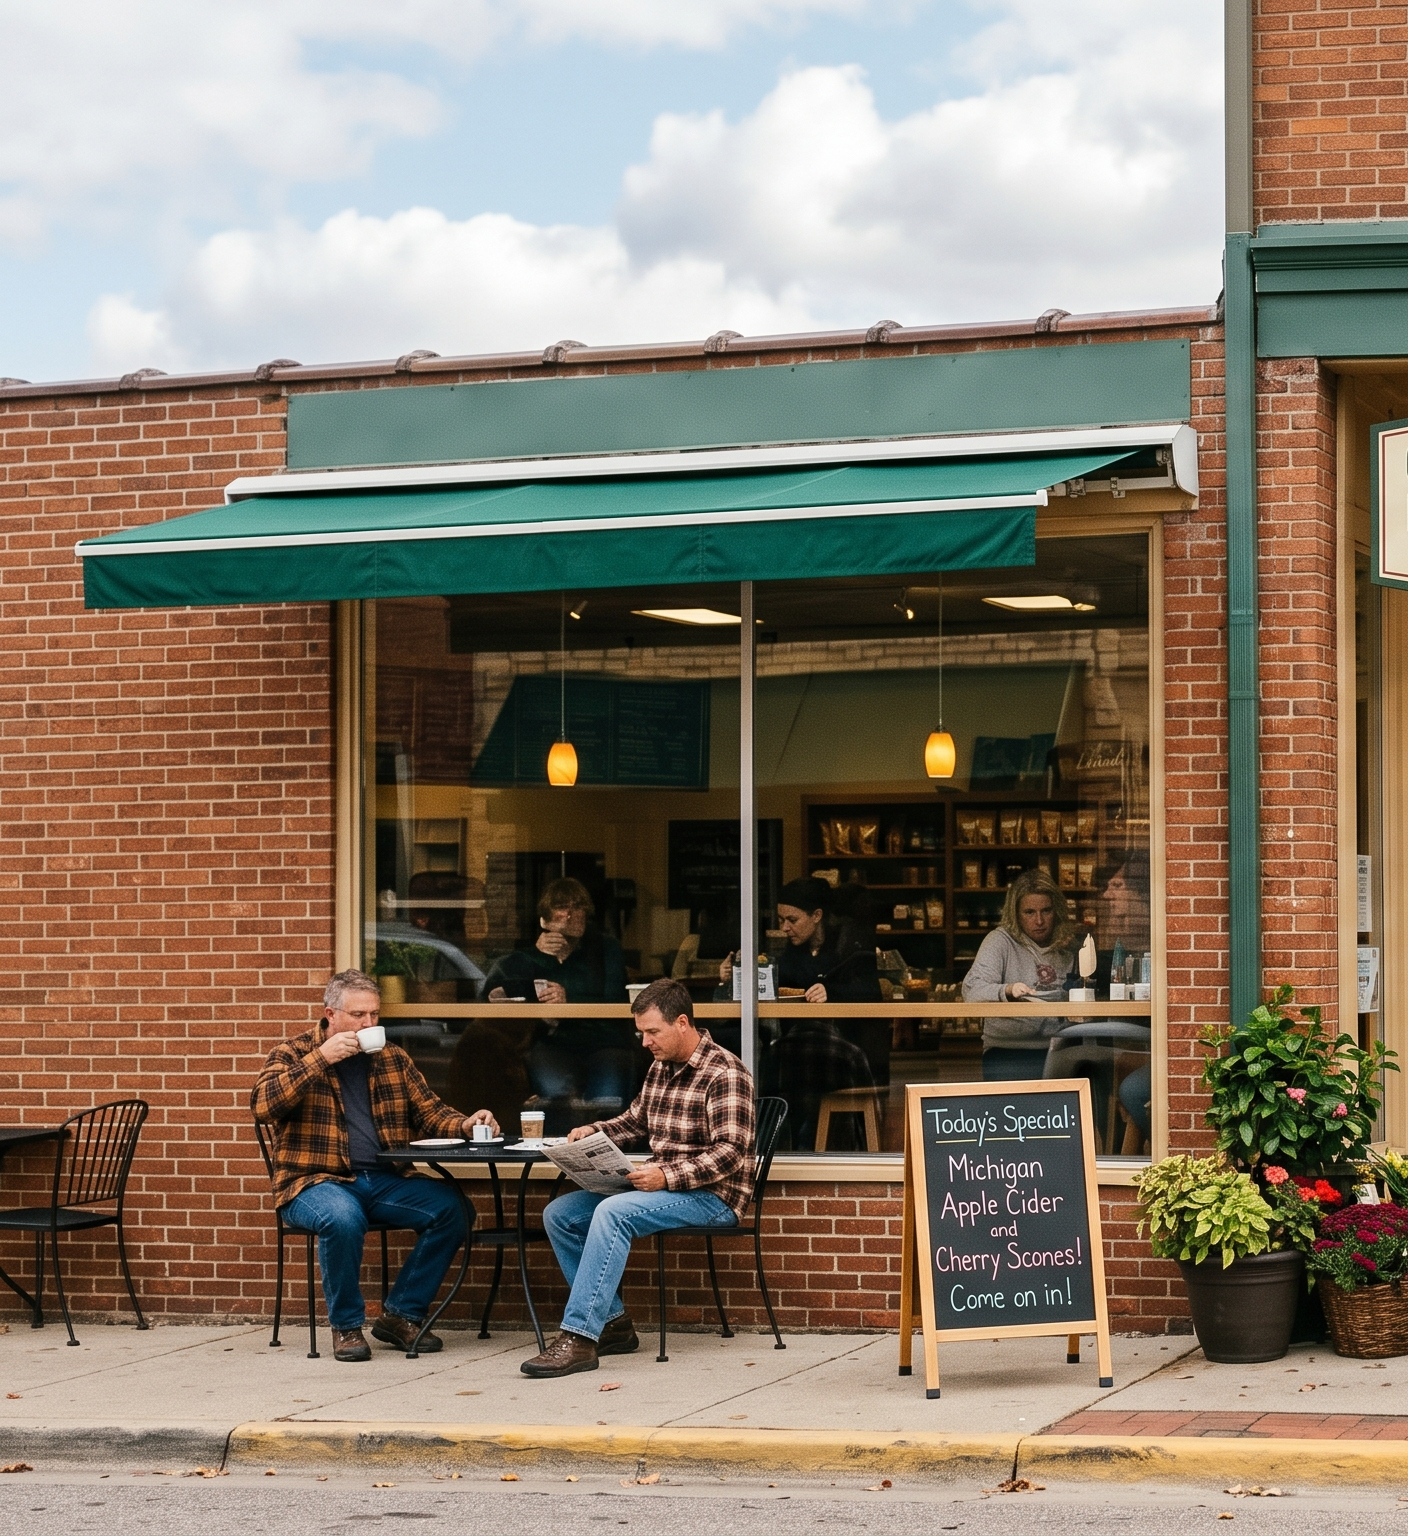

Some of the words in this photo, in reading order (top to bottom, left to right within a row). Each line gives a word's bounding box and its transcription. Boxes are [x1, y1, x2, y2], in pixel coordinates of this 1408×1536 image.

[926, 1108, 998, 1147] Today's
[1003, 1104, 1076, 1142] Special:
[948, 1153, 1044, 1189] Michigan
[940, 1190, 998, 1228] Apple
[1006, 1187, 1064, 1215] Cider
[990, 1219, 1018, 1238] and
[935, 1246, 1001, 1281] Cherry
[1006, 1236, 1082, 1270] Scones!
[950, 1284, 1006, 1312] Come
[1013, 1291, 1037, 1308] on
[1044, 1276, 1072, 1306] in!
